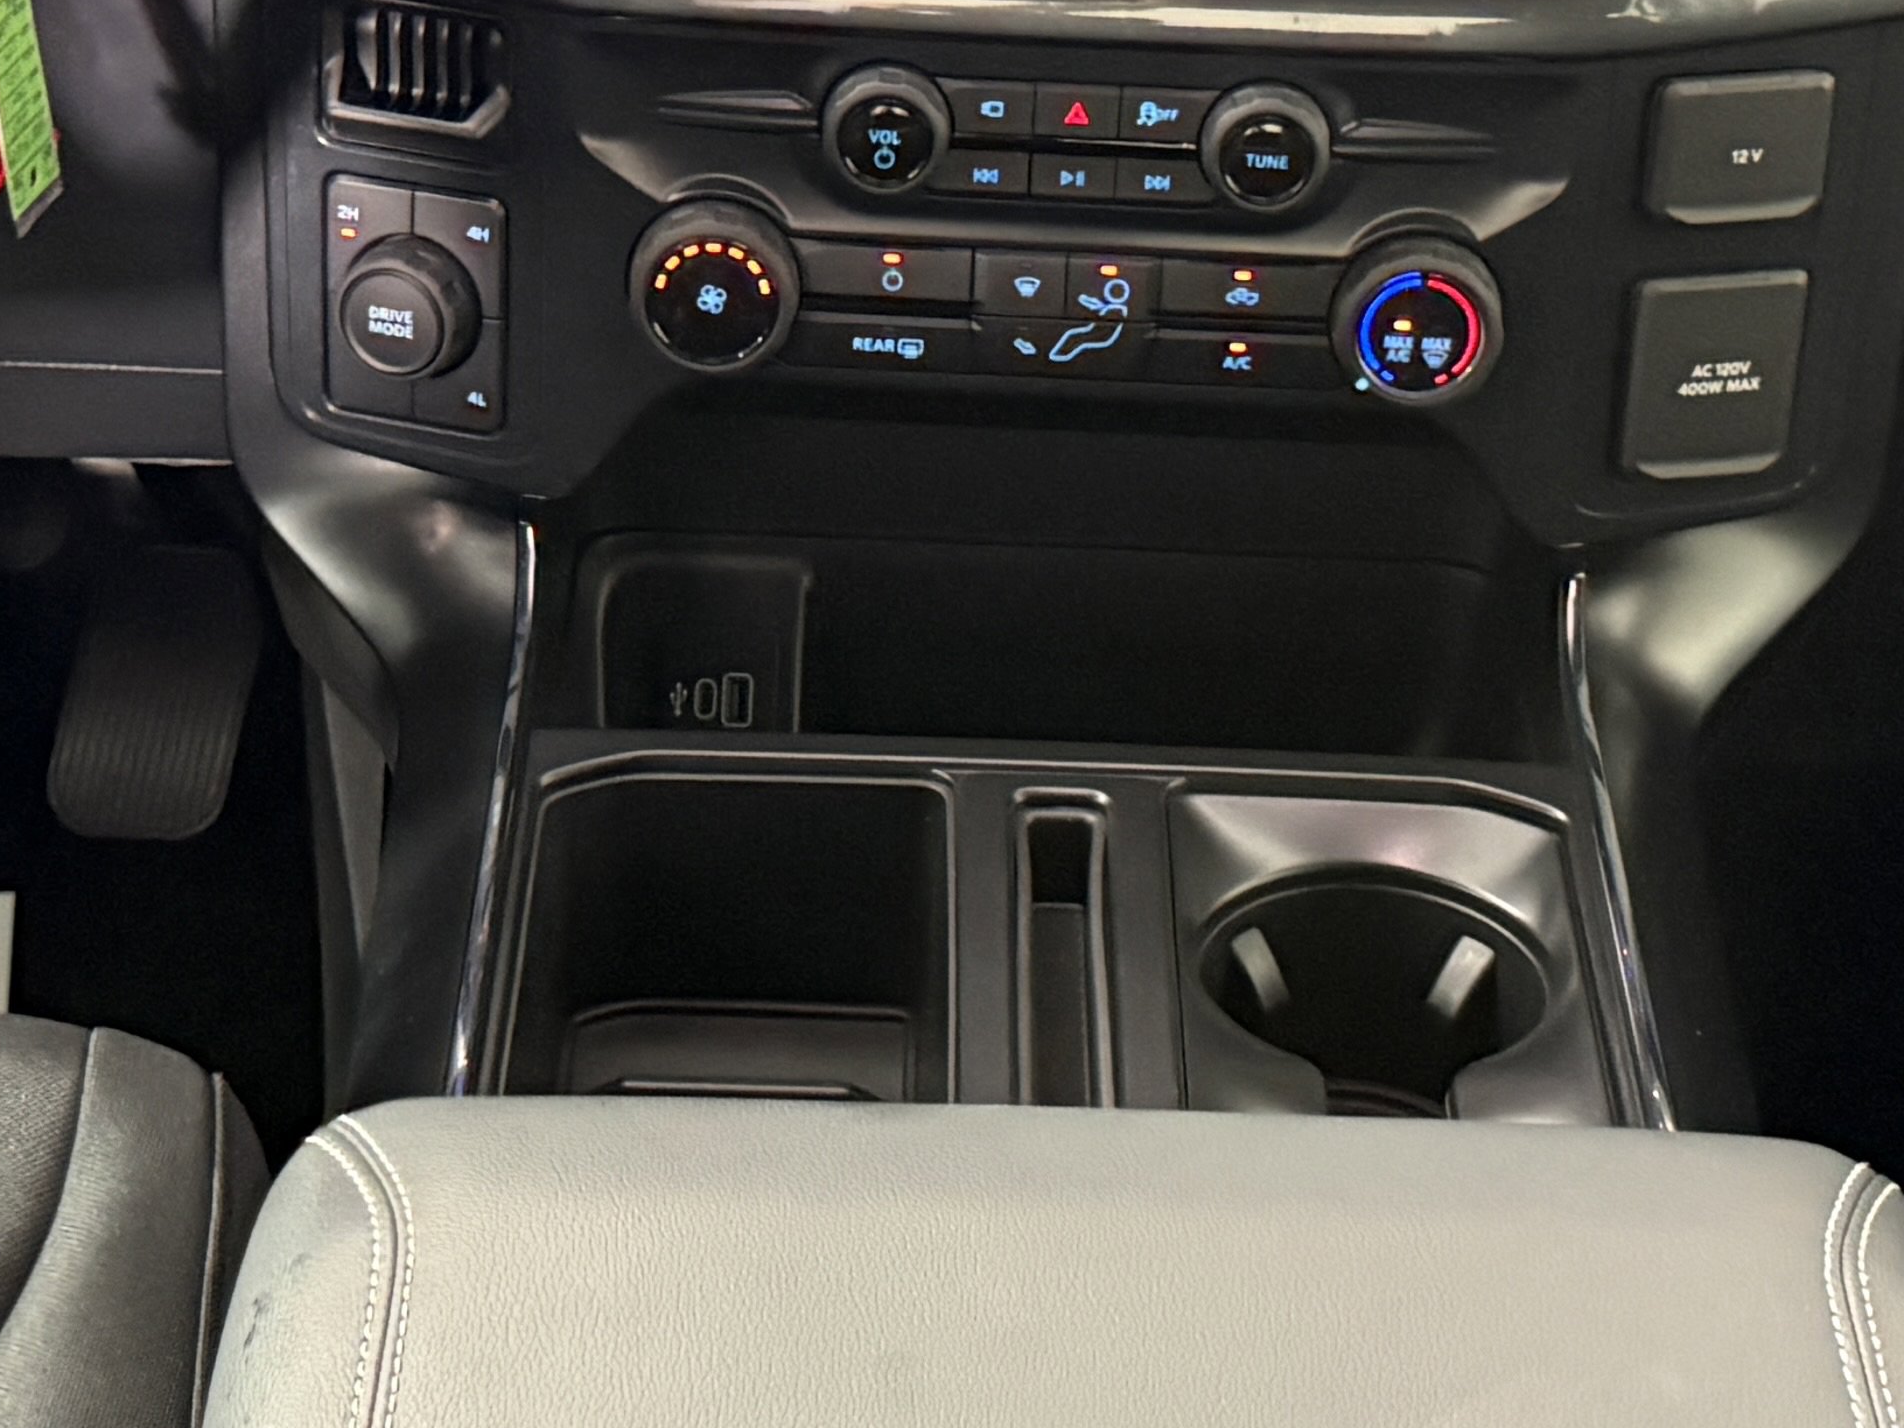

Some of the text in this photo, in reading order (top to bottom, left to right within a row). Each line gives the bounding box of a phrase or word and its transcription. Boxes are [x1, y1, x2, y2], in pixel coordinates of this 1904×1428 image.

[1157, 108, 1180, 122] OFF
[868, 129, 902, 147] VOL
[1245, 152, 1289, 171] TUNE
[1731, 148, 1763, 164] 12 V
[336, 204, 359, 222] 2H
[466, 225, 490, 243] 4H
[368, 304, 414, 325] DRIVE
[368, 319, 414, 340] MODE
[852, 337, 895, 353] REAR
[1382, 335, 1414, 349] MAX
[1420, 337, 1452, 351] MAX
[1222, 355, 1252, 371] A/C
[1385, 348, 1412, 363] A/C
[1690, 360, 1752, 378] AC 120V
[1677, 376, 1761, 397] 400W MAX
[466, 390, 487, 408] 4L
